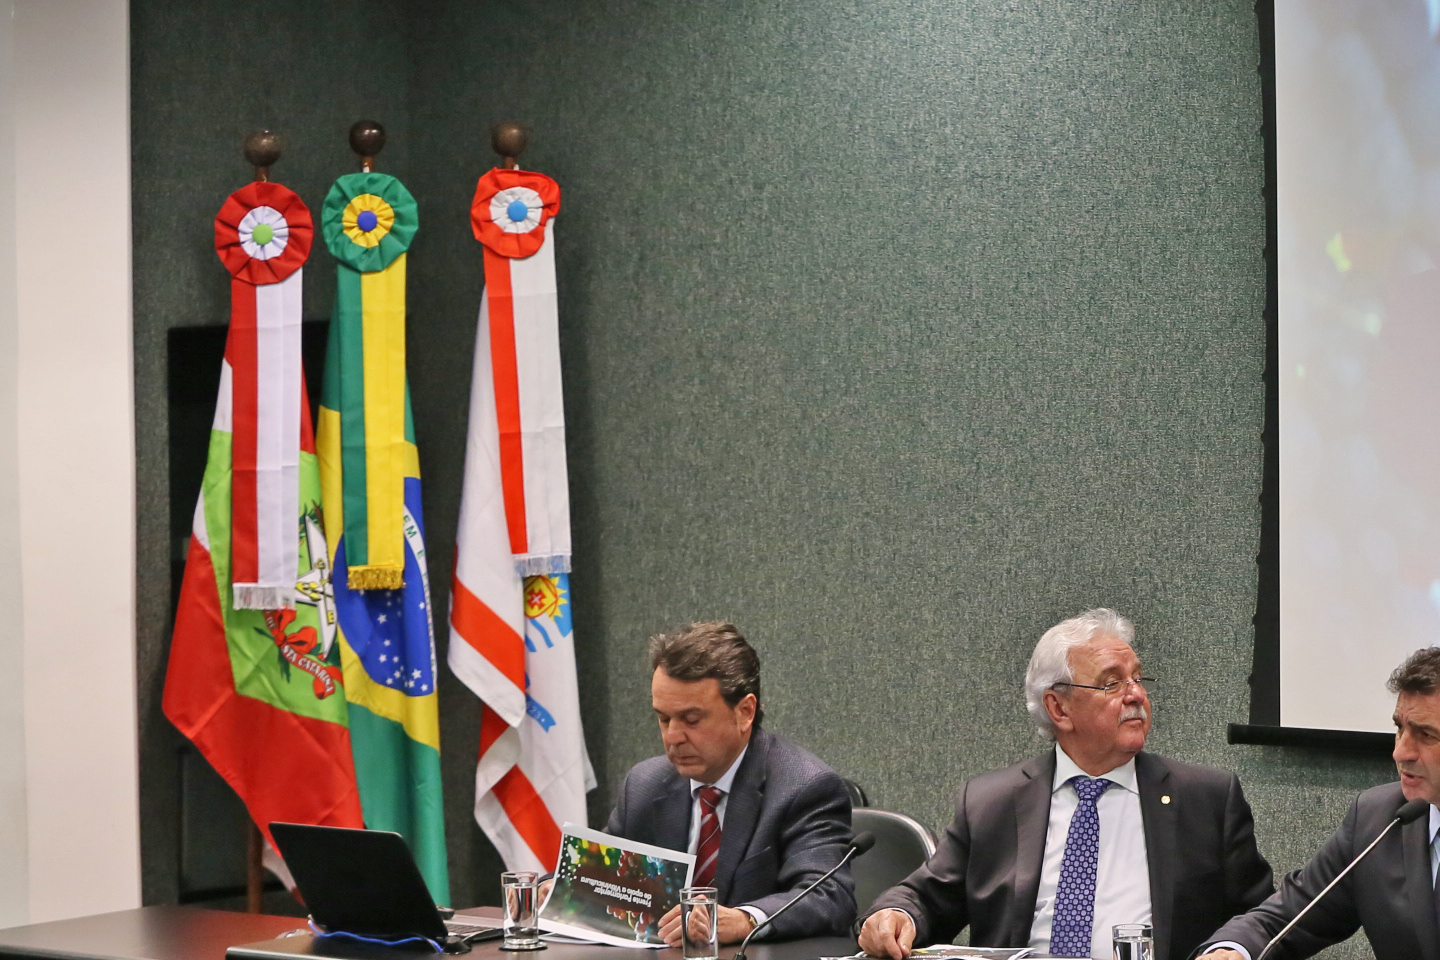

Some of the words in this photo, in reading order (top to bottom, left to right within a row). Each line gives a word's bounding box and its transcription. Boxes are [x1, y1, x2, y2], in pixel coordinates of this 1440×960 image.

[298, 657, 334, 693] CATARINA
[593, 886, 632, 903] Parlamentar
[626, 888, 643, 897] apoio
[643, 892, 652, 900] de
[632, 896, 652, 908] Frente
